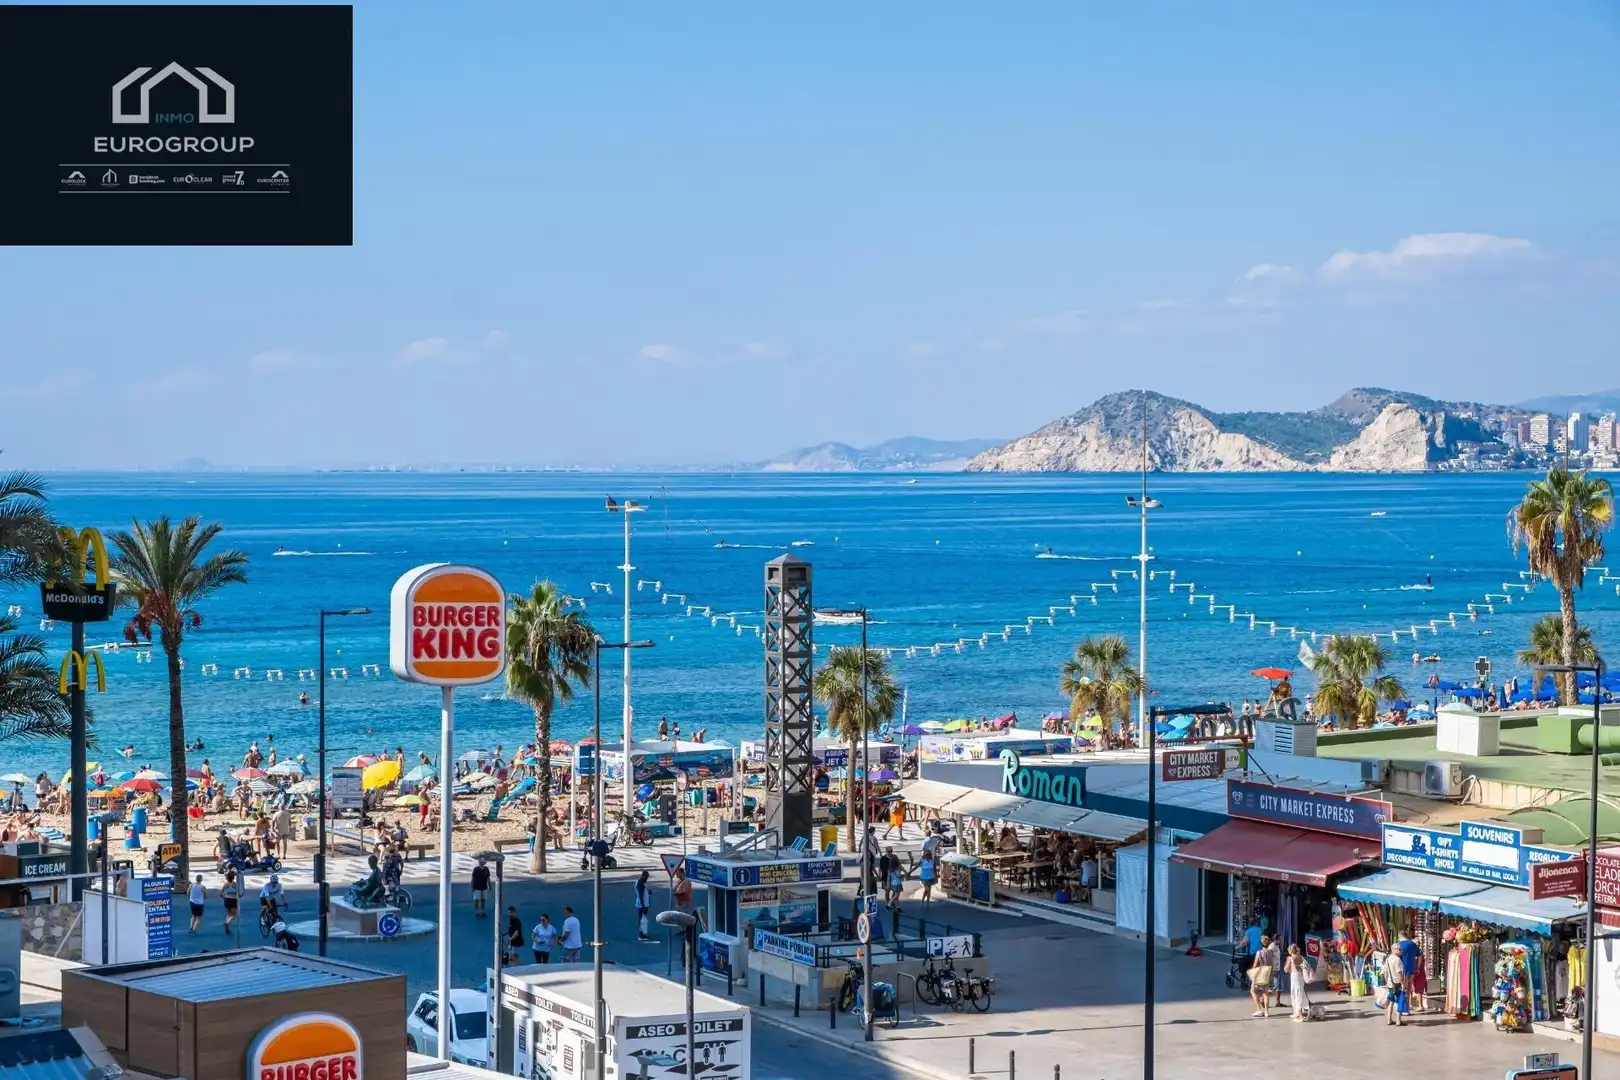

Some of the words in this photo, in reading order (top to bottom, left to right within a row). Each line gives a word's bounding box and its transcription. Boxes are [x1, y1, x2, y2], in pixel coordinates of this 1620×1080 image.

[45, 592, 105, 605] McDonald's
[412, 605, 500, 627] BURGER
[412, 628, 500, 659] KING
[1169, 753, 1187, 766] CITY
[1187, 751, 1218, 765] MARKET
[1000, 748, 1083, 805] Roman
[1177, 765, 1211, 778] EXPRESS
[1260, 794, 1278, 811] CITY
[1280, 798, 1314, 817] MARKET
[1316, 803, 1354, 824] EXPRESS
[1437, 836, 1453, 847] GIFT
[1467, 826, 1515, 844] SOUVENIRS
[161, 846, 181, 856] ATM
[1431, 847, 1459, 859] T-SHIRTS
[1529, 851, 1560, 863] REGALOS
[1386, 852, 1427, 867] DECORACIÓN
[1434, 857, 1455, 870] SHOES
[25, 864, 37, 875] ICE
[38, 862, 66, 875] CREAM
[1502, 872, 1515, 881] LOCAL
[144, 880, 170, 888] ALQUILER
[148, 899, 169, 907] OLIDAY
[148, 905, 170, 913] ENTALS
[764, 933, 789, 950] PARKING
[790, 939, 815, 958] PÚBLICO
[930, 940, 943, 956] P
[505, 984, 519, 998] ASEO
[535, 995, 554, 1012] TOILET
[638, 1024, 676, 1038] ASEO
[261, 1056, 357, 1080] BURGER
